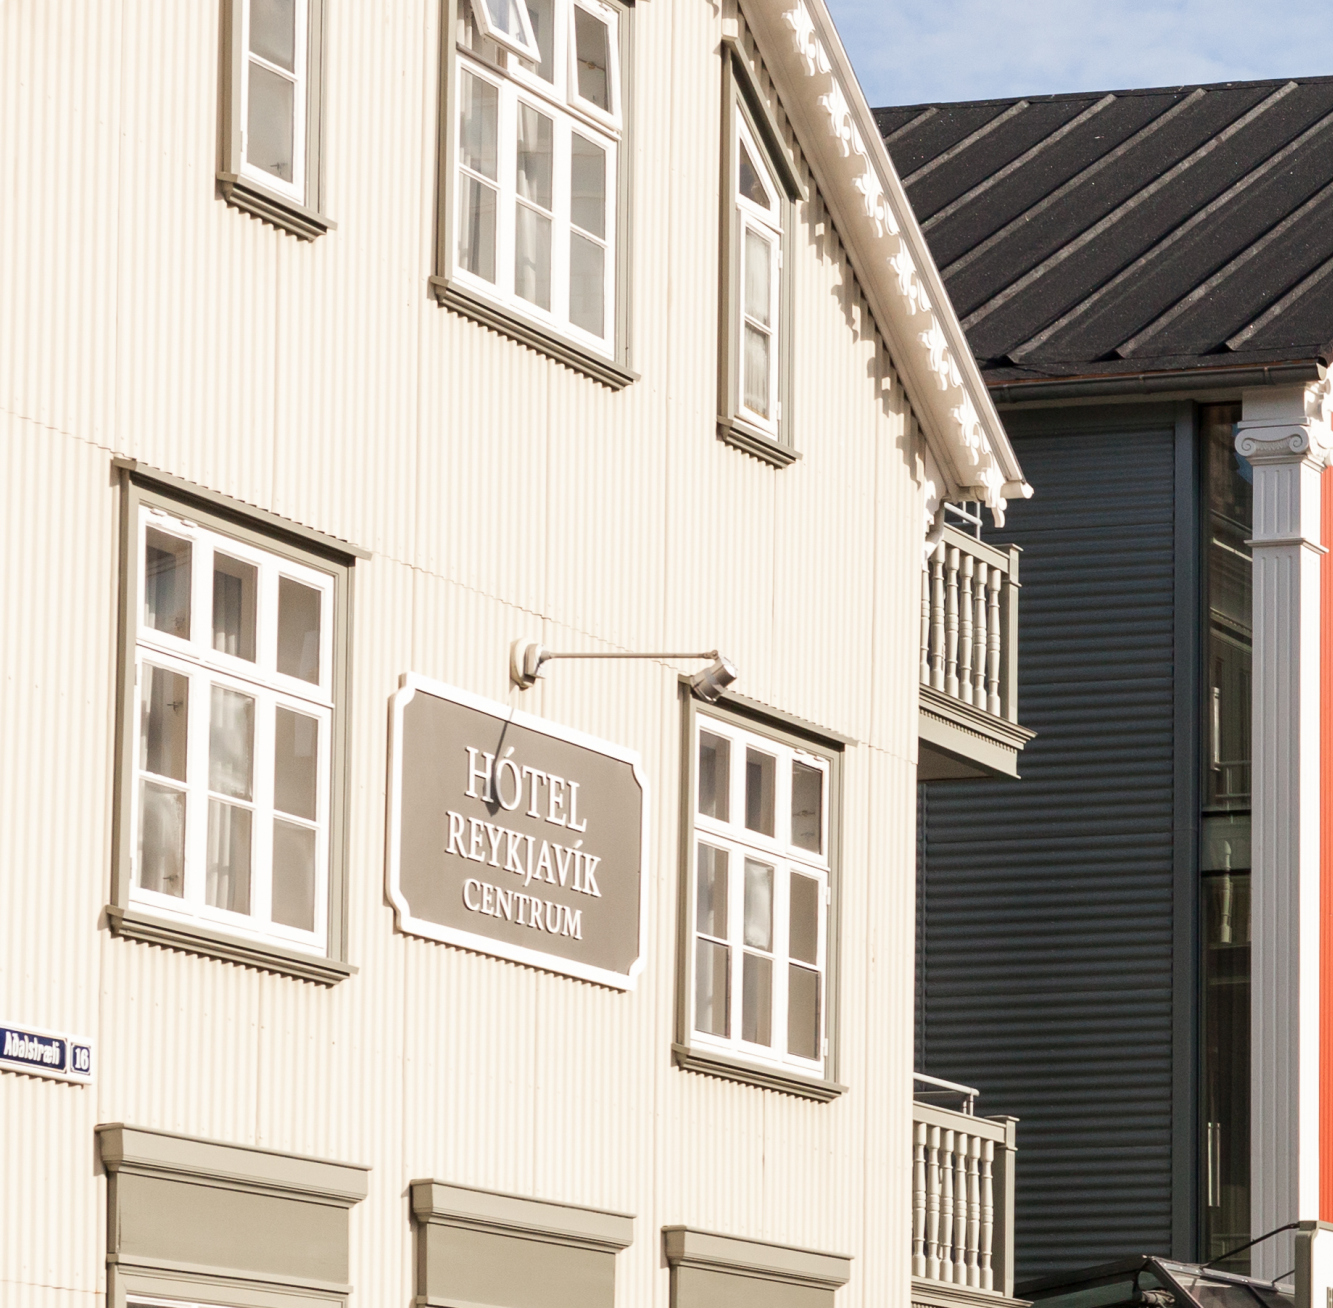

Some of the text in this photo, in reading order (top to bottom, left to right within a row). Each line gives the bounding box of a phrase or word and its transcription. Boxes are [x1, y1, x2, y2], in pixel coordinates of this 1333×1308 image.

[465, 746, 588, 833] HÓTEL
[445, 810, 602, 898] REYKJAVÍK
[463, 877, 583, 940] CENTRUM
[74, 1047, 89, 1070] 16
